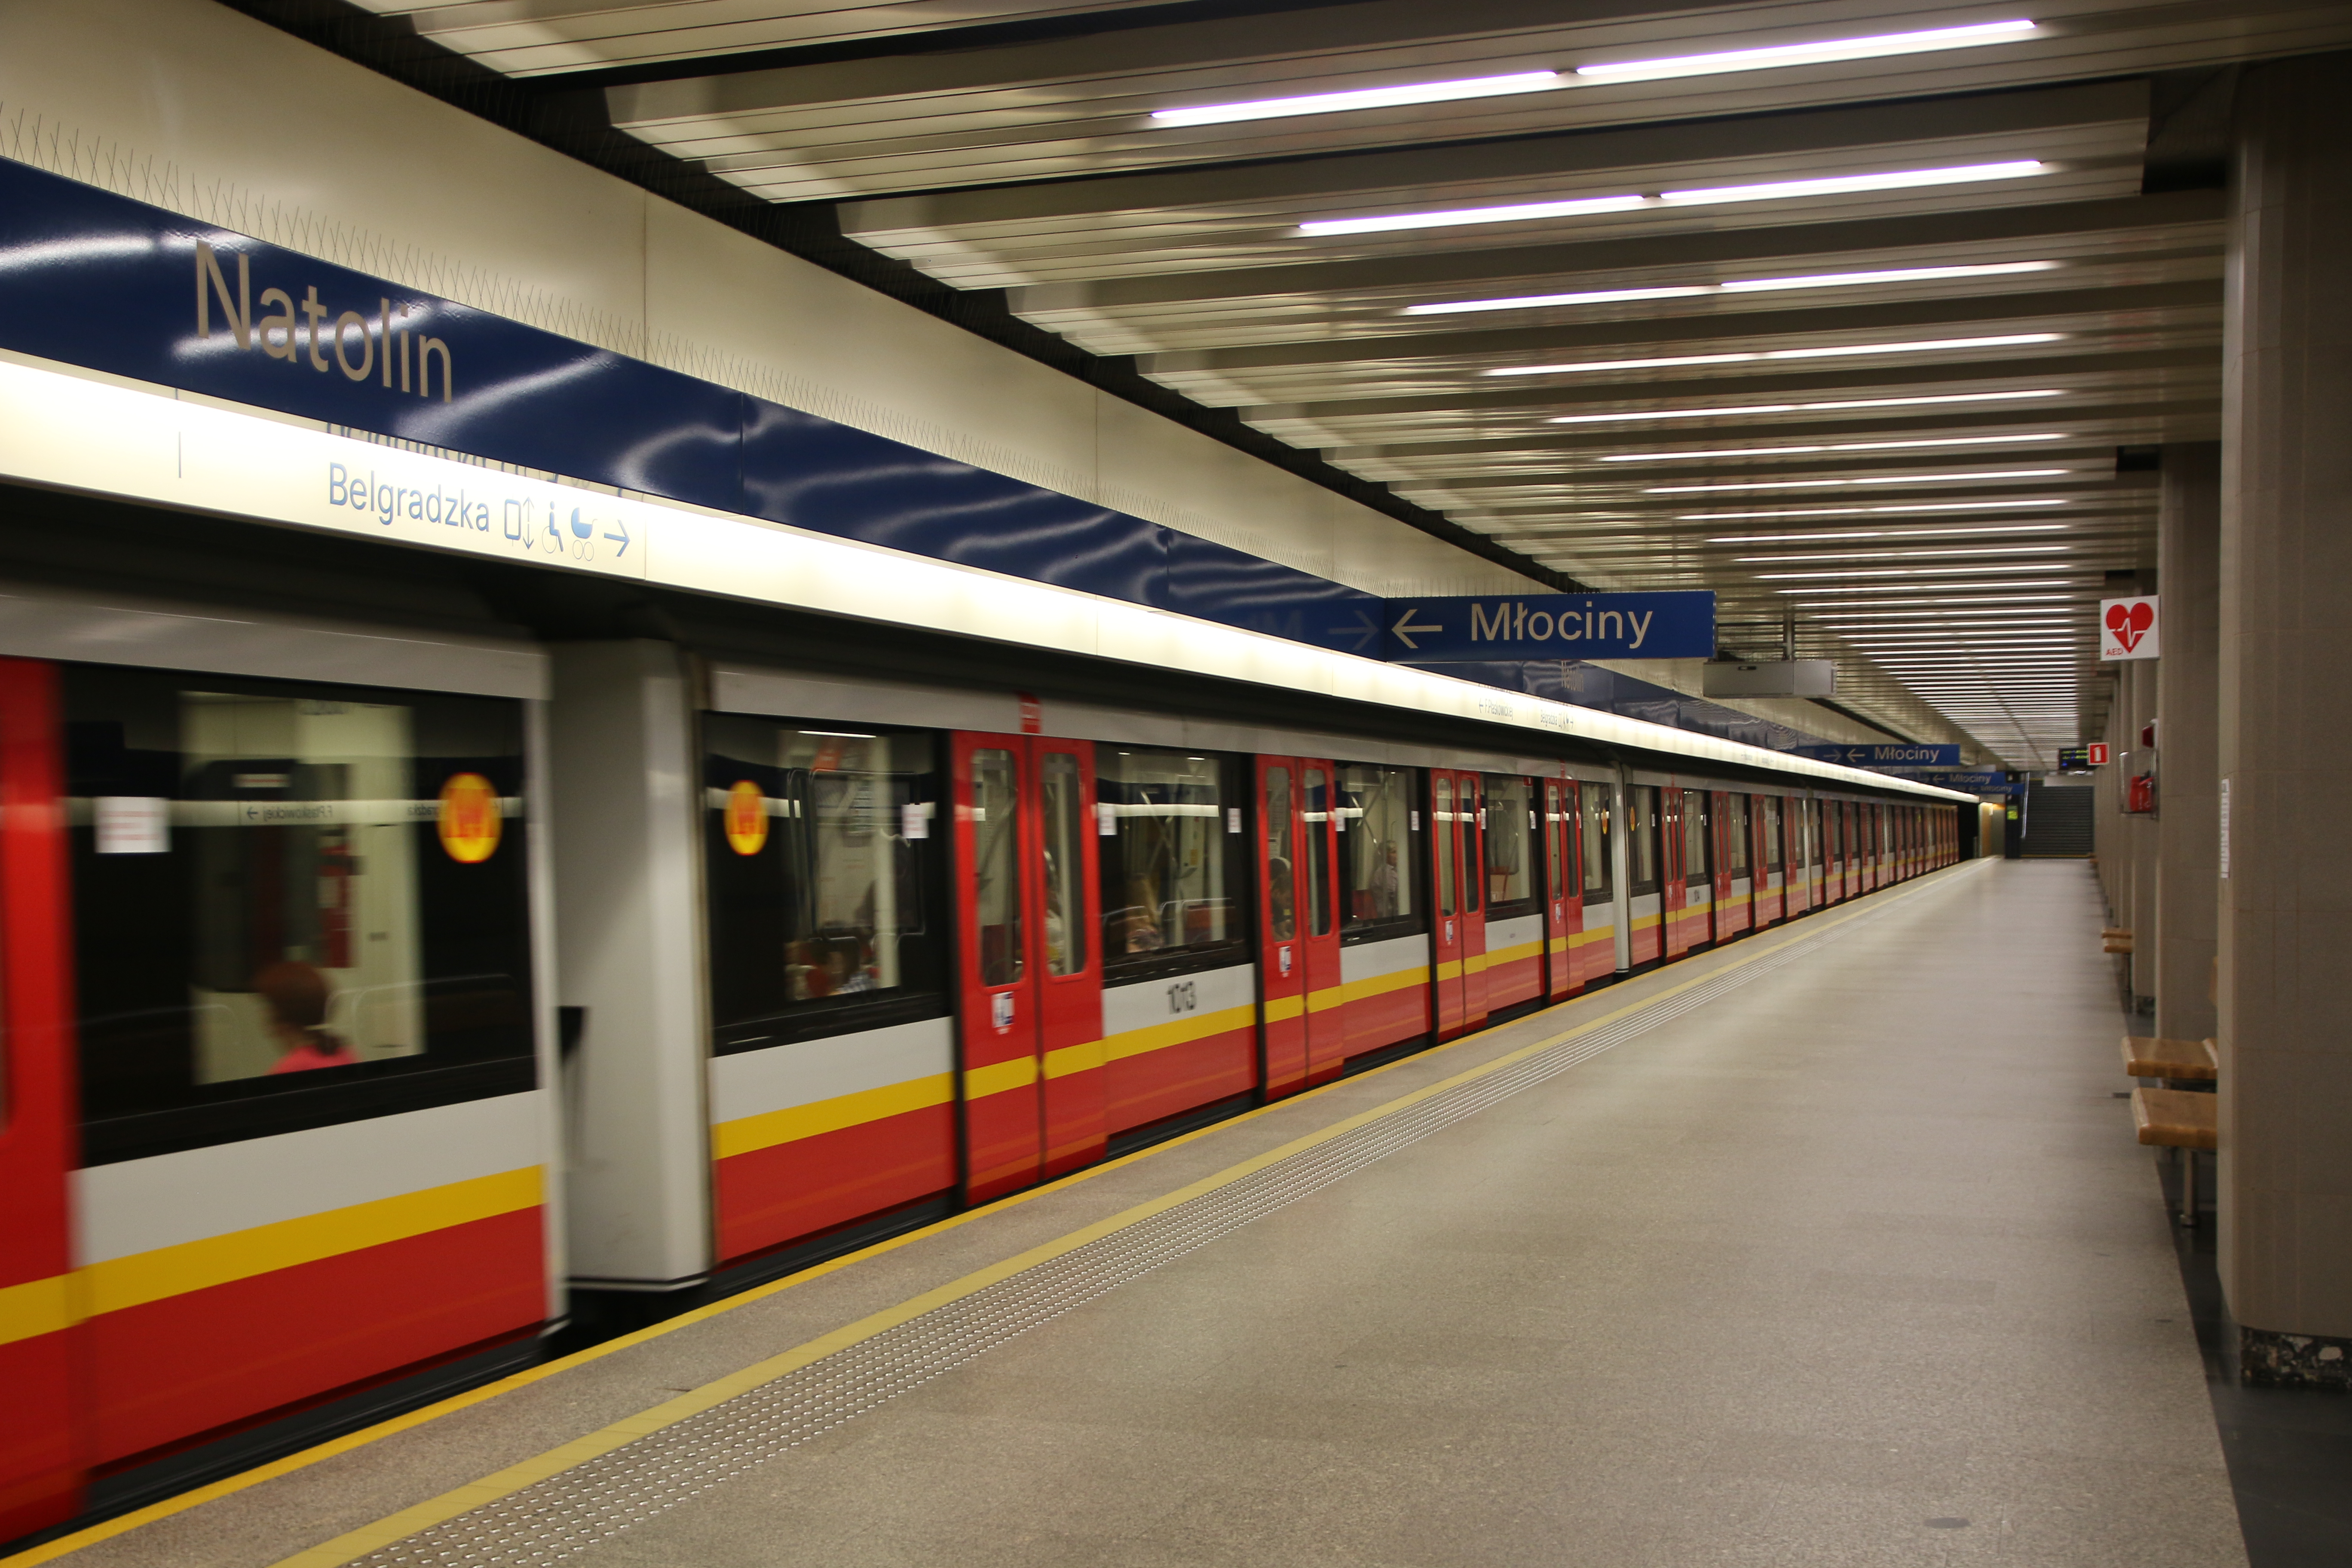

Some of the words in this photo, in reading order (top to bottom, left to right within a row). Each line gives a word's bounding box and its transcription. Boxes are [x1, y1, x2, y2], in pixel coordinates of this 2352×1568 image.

[196, 239, 452, 403] Natolin
[329, 462, 490, 533] Belgradzka
[1470, 600, 1653, 649] Młociny
[2105, 648, 2123, 656] AED
[1874, 746, 1940, 763] Młociny
